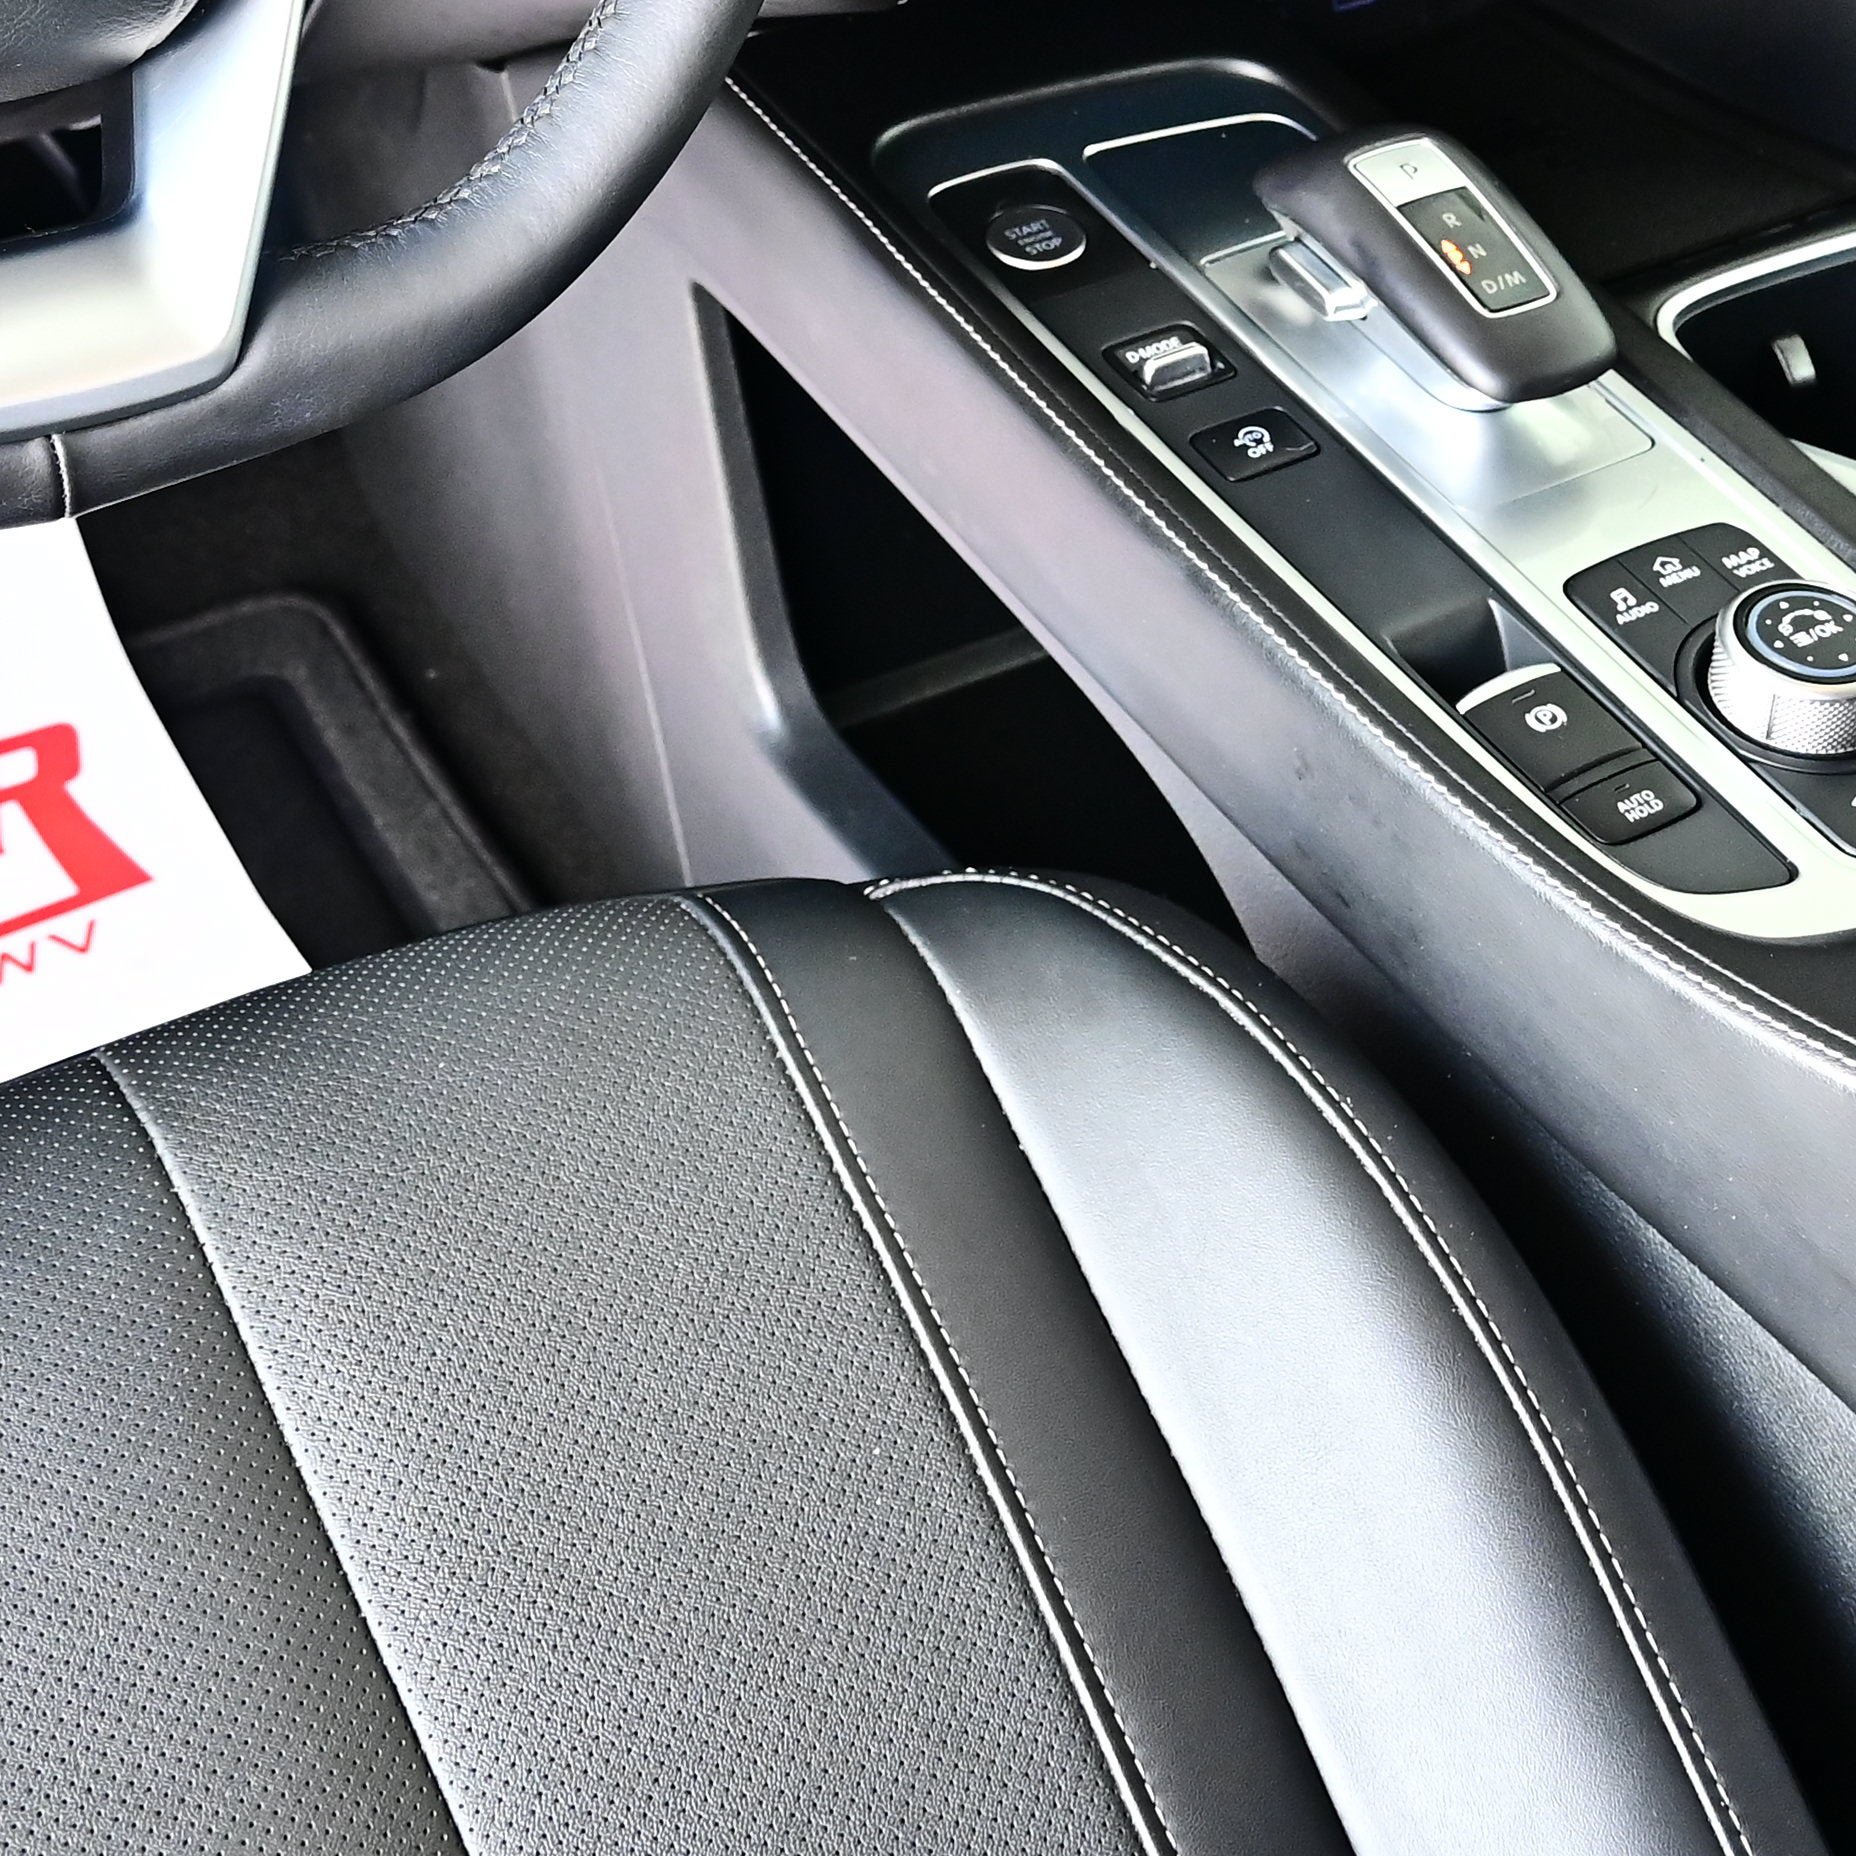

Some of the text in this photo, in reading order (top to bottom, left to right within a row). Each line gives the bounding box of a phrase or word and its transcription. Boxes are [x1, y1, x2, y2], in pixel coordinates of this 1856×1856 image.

[1004, 219, 1050, 241] START
[1441, 211, 1463, 229] R
[1024, 236, 1063, 256] STOP
[1467, 243, 1488, 260] N
[1480, 270, 1528, 295] D/M
[1721, 546, 1761, 570] MAP
[1732, 557, 1775, 579] VOICE
[1658, 565, 1702, 588] MENU
[1615, 600, 1661, 626] AUDIO
[1616, 789, 1656, 814] AUTO
[1623, 798, 1665, 824] HOLD
